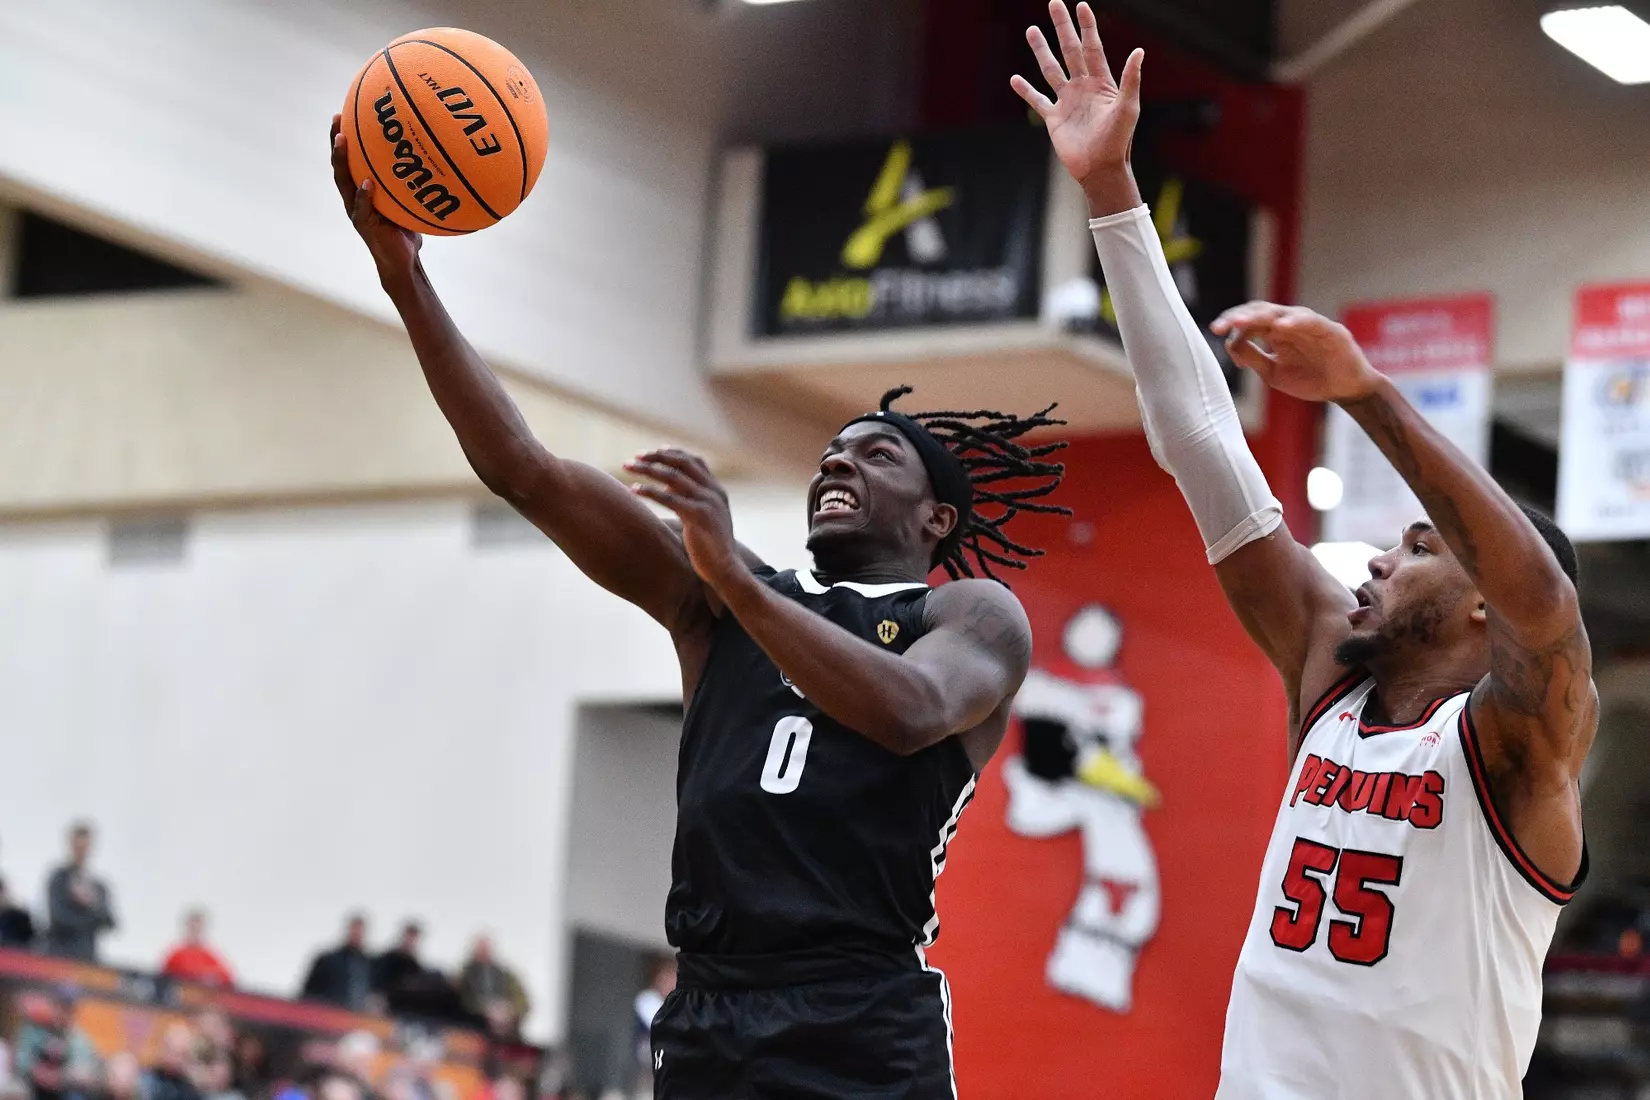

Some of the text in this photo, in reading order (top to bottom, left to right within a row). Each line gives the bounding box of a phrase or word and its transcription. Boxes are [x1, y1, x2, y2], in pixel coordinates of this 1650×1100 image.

[374, 91, 461, 221] Wilson
[417, 72, 502, 157] EVO NXT
[759, 715, 813, 794] 0
[1269, 836, 1404, 967] 55
